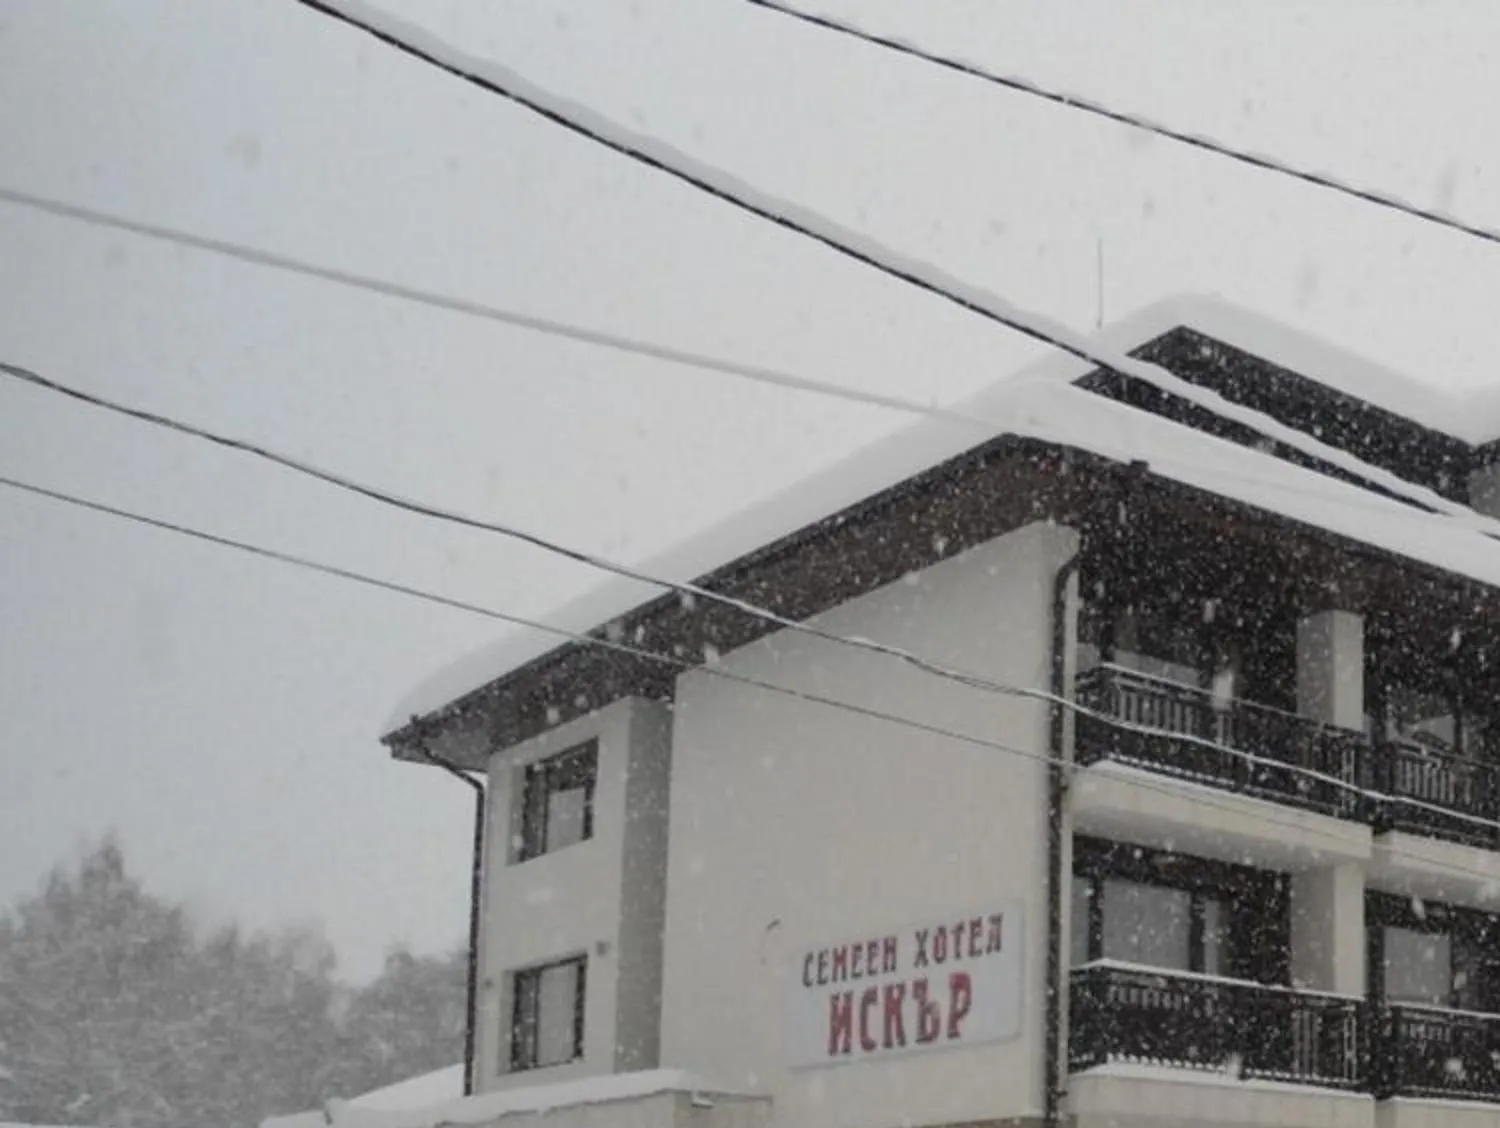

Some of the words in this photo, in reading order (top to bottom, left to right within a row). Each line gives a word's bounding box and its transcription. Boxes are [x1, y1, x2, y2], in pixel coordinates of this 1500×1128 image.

[802, 936, 898, 988] СЕМЕЕН
[914, 912, 1004, 969] ХОТЕЛ
[828, 971, 972, 1056] ИСКЪР
